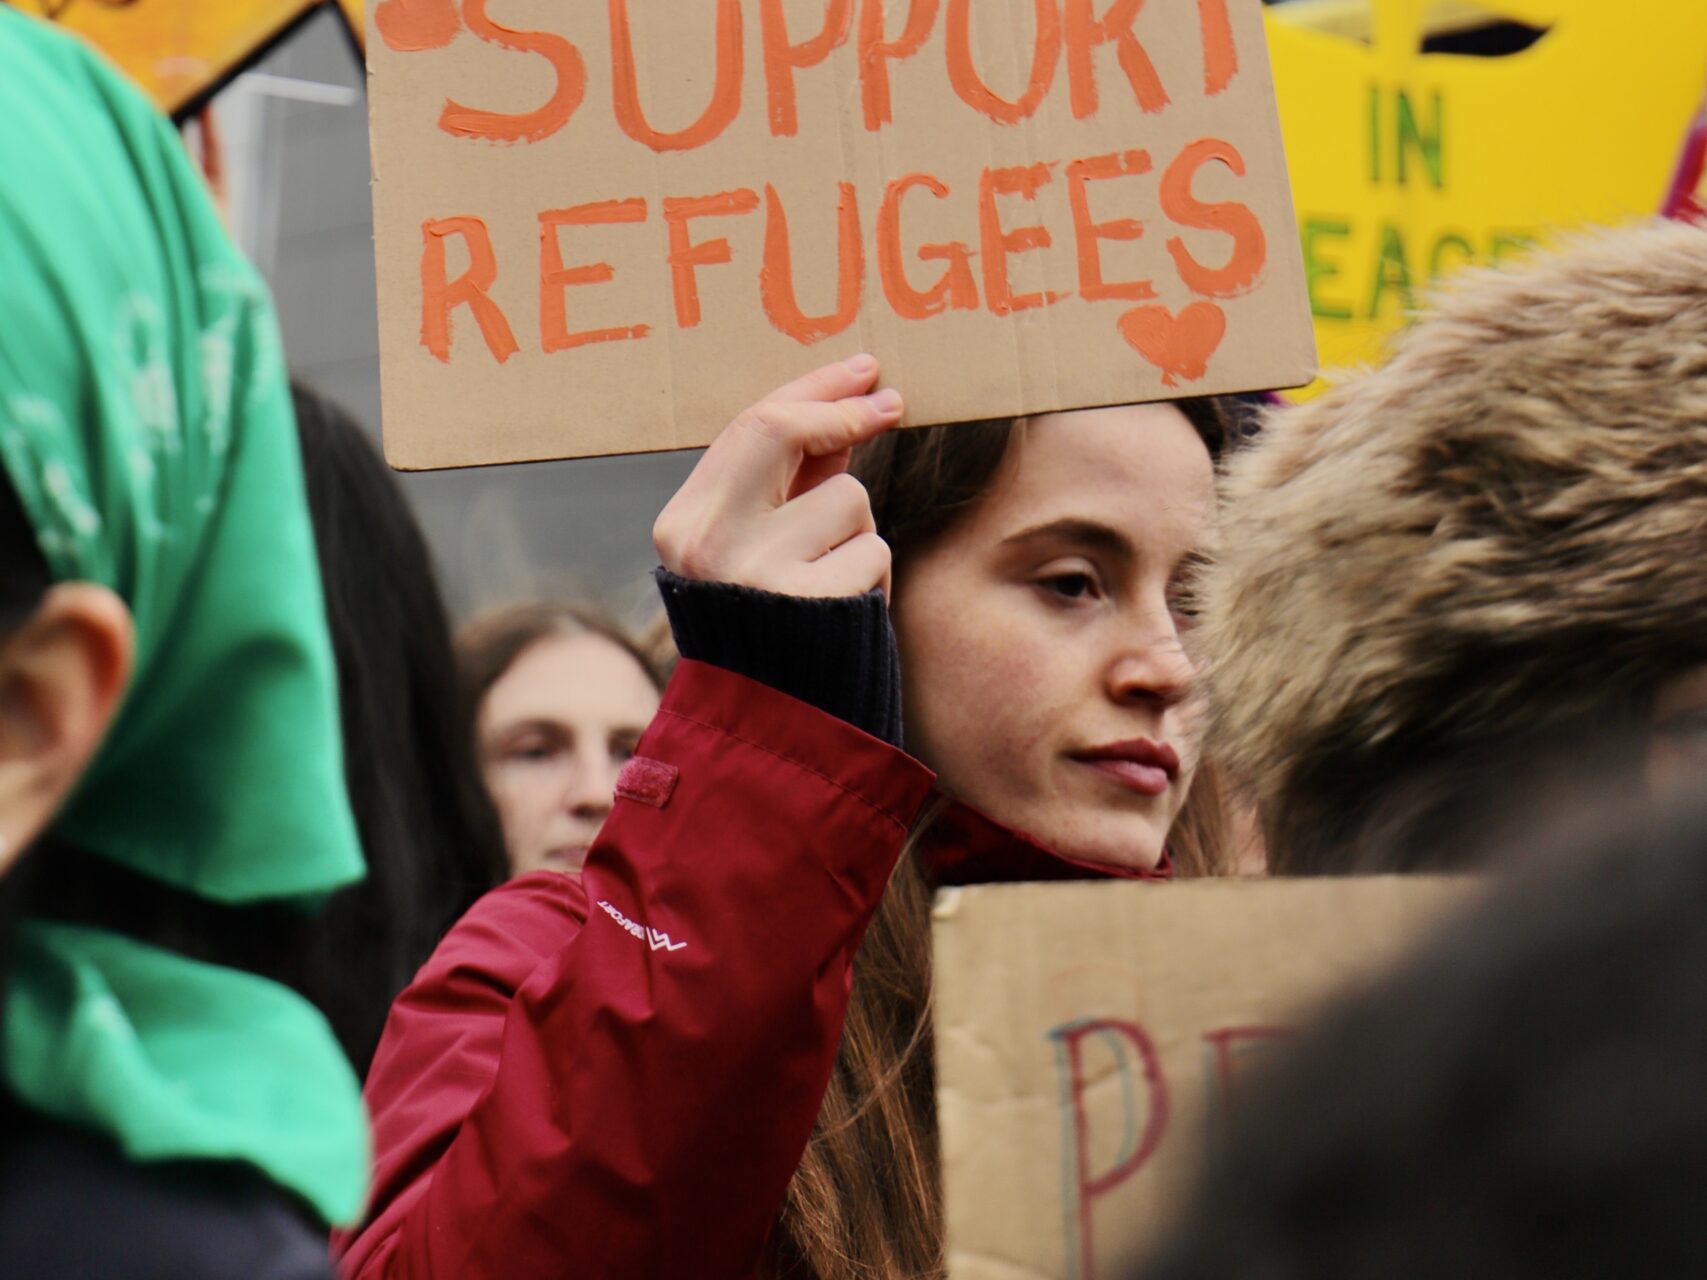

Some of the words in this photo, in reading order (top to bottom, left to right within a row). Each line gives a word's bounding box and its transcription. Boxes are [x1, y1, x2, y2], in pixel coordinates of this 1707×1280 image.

[1367, 83, 1444, 190] IN
[419, 137, 1267, 366] REFUGEES
[1301, 219, 1542, 323] EAC
